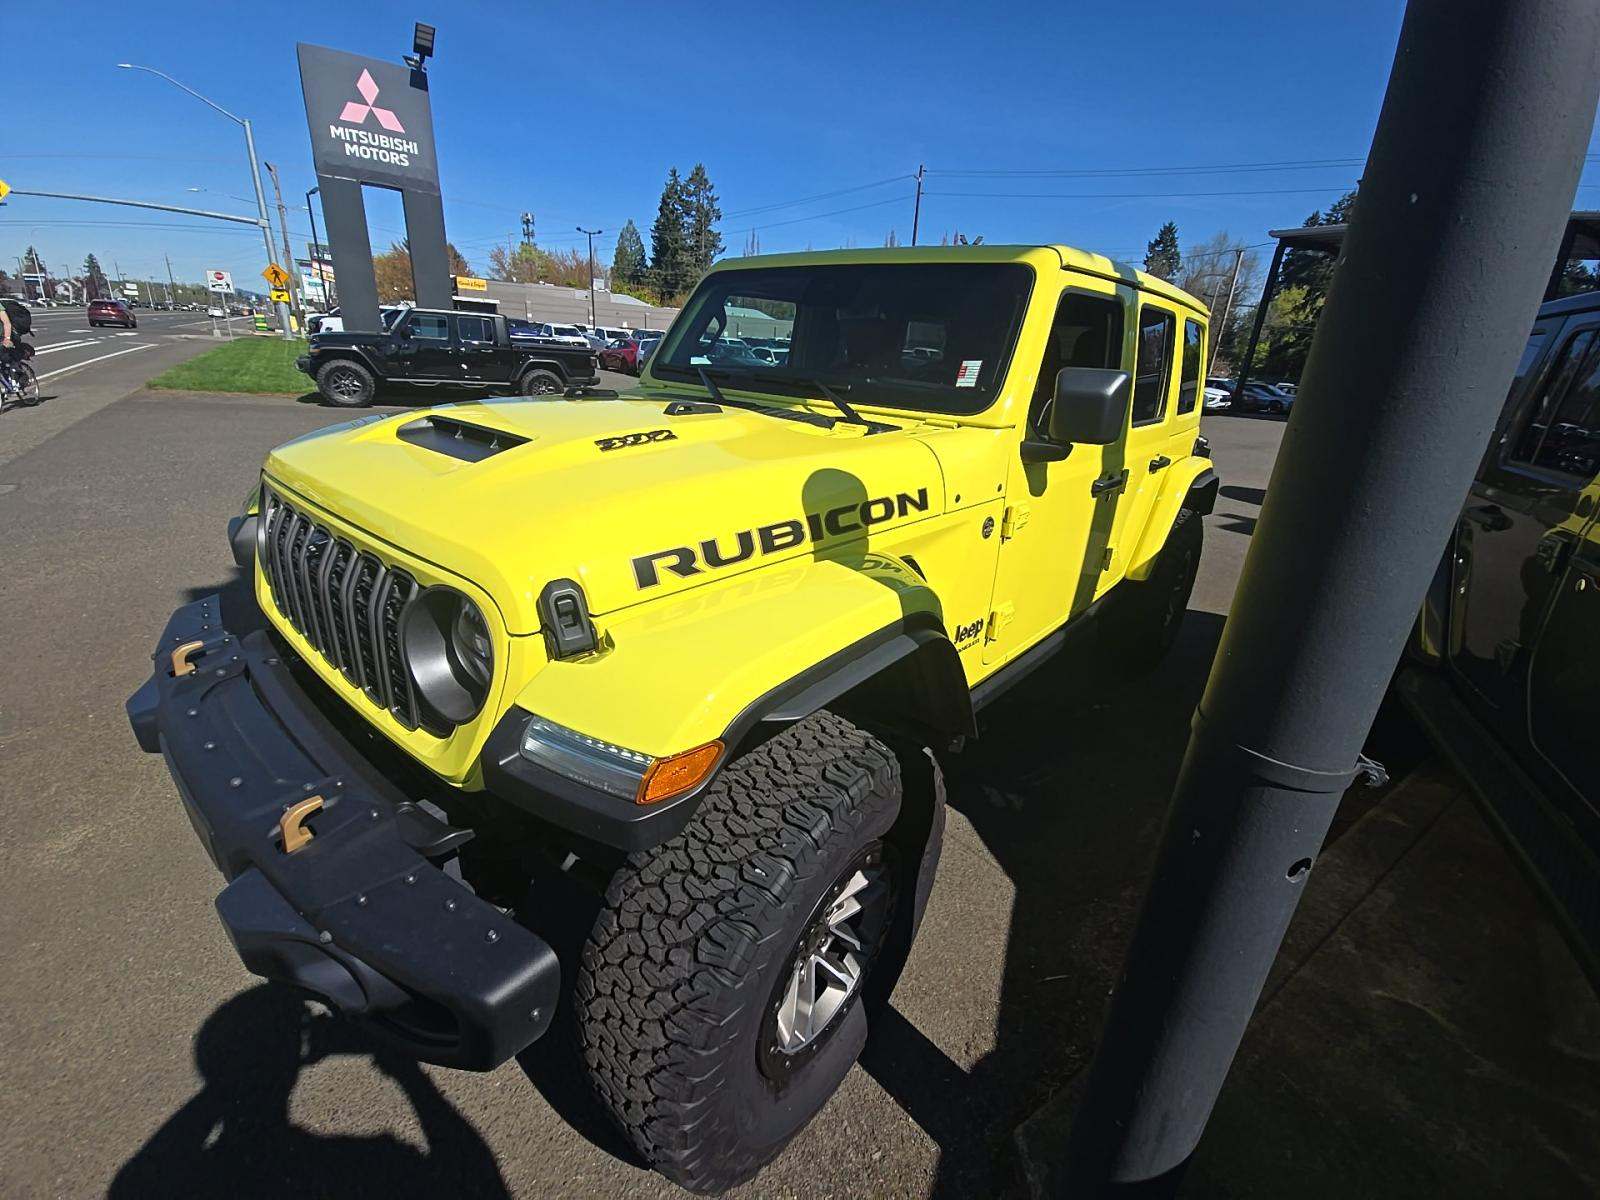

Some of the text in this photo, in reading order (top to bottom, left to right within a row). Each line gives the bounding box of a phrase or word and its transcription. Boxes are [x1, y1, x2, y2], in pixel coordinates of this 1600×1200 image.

[329, 125, 418, 155] MITSUBISHI
[344, 142, 410, 167] MOTORS
[632, 487, 929, 590] RUBICON
[954, 618, 984, 644] Jeep
